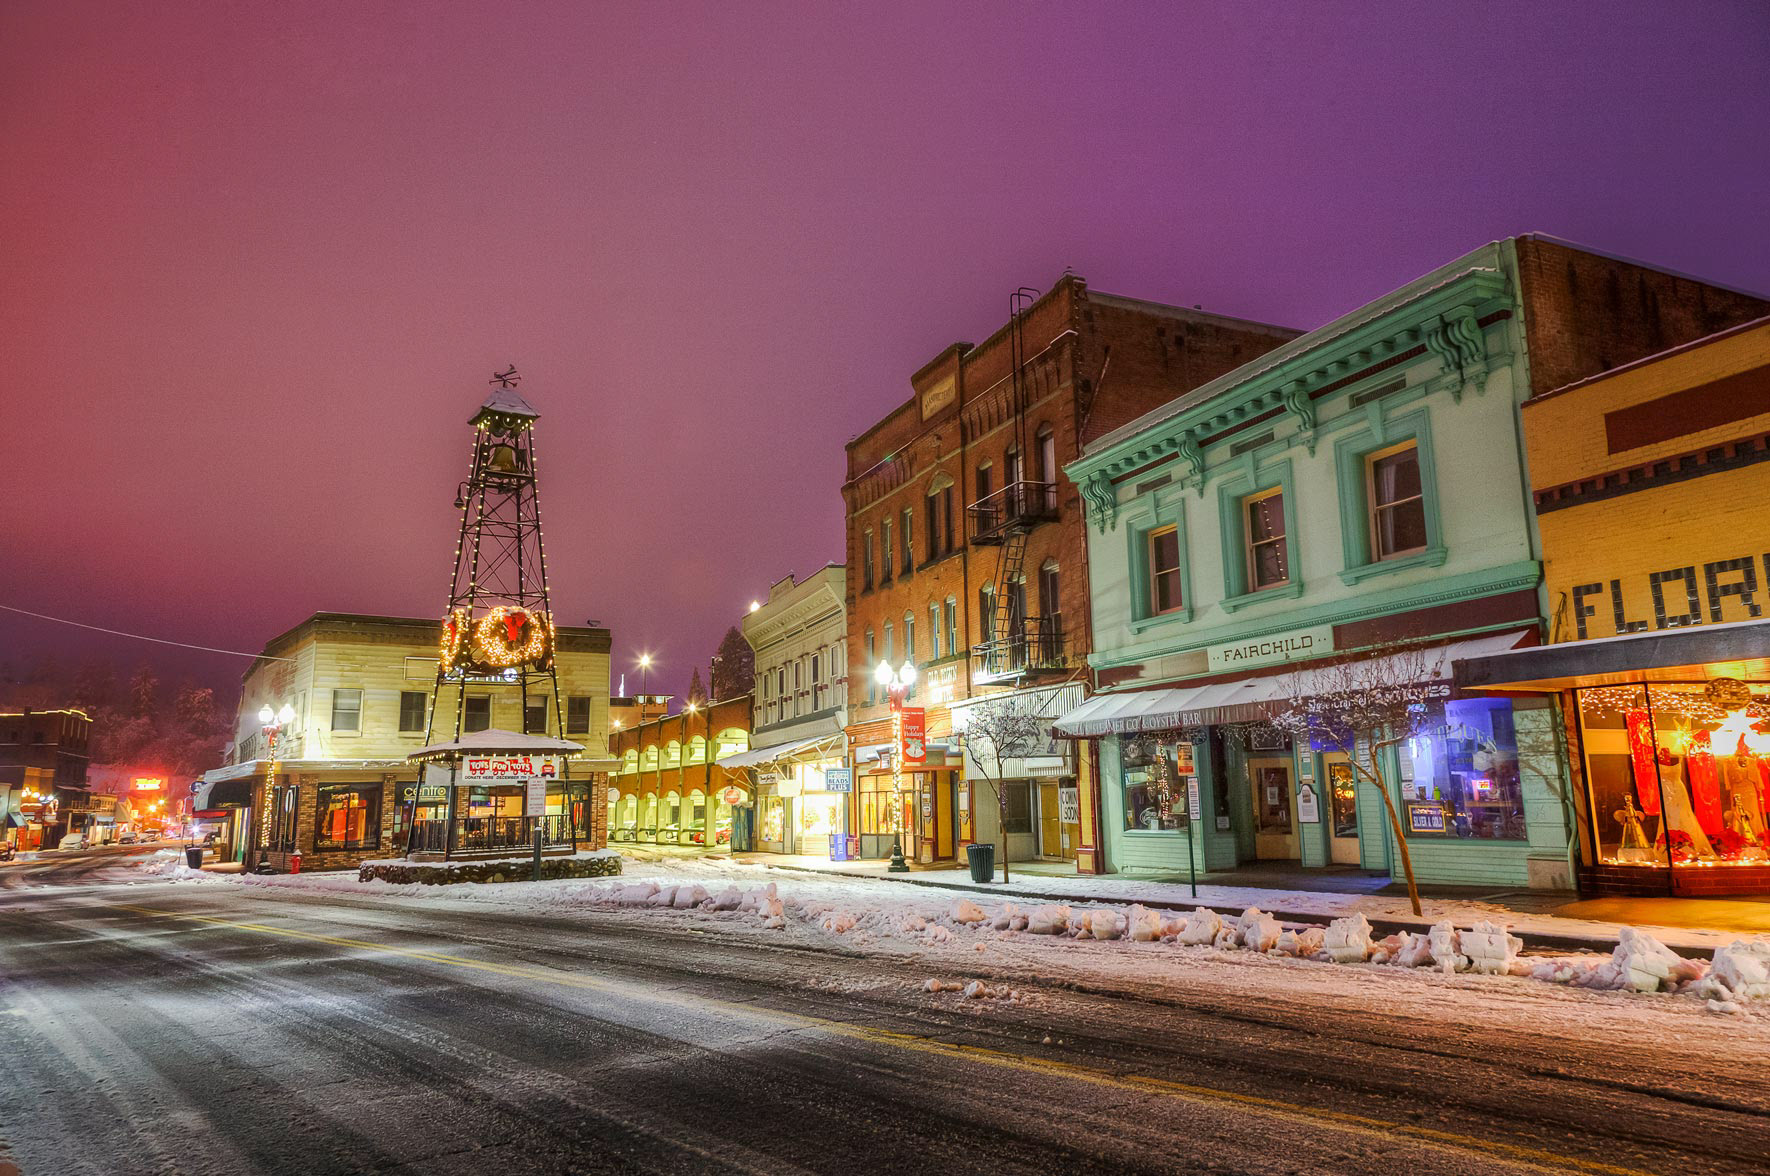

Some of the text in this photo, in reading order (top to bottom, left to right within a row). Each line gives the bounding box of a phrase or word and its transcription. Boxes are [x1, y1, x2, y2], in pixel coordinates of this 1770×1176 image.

[1224, 635, 1313, 661] FAIRCHILD
[1149, 714, 1181, 728] OYSTER
[1183, 712, 1201, 725] BAR
[903, 724, 920, 734] Happy
[470, 761, 530, 771] TOYS FOR TOTS
[403, 785, 447, 796] centro
[1061, 791, 1078, 805] COMIN
